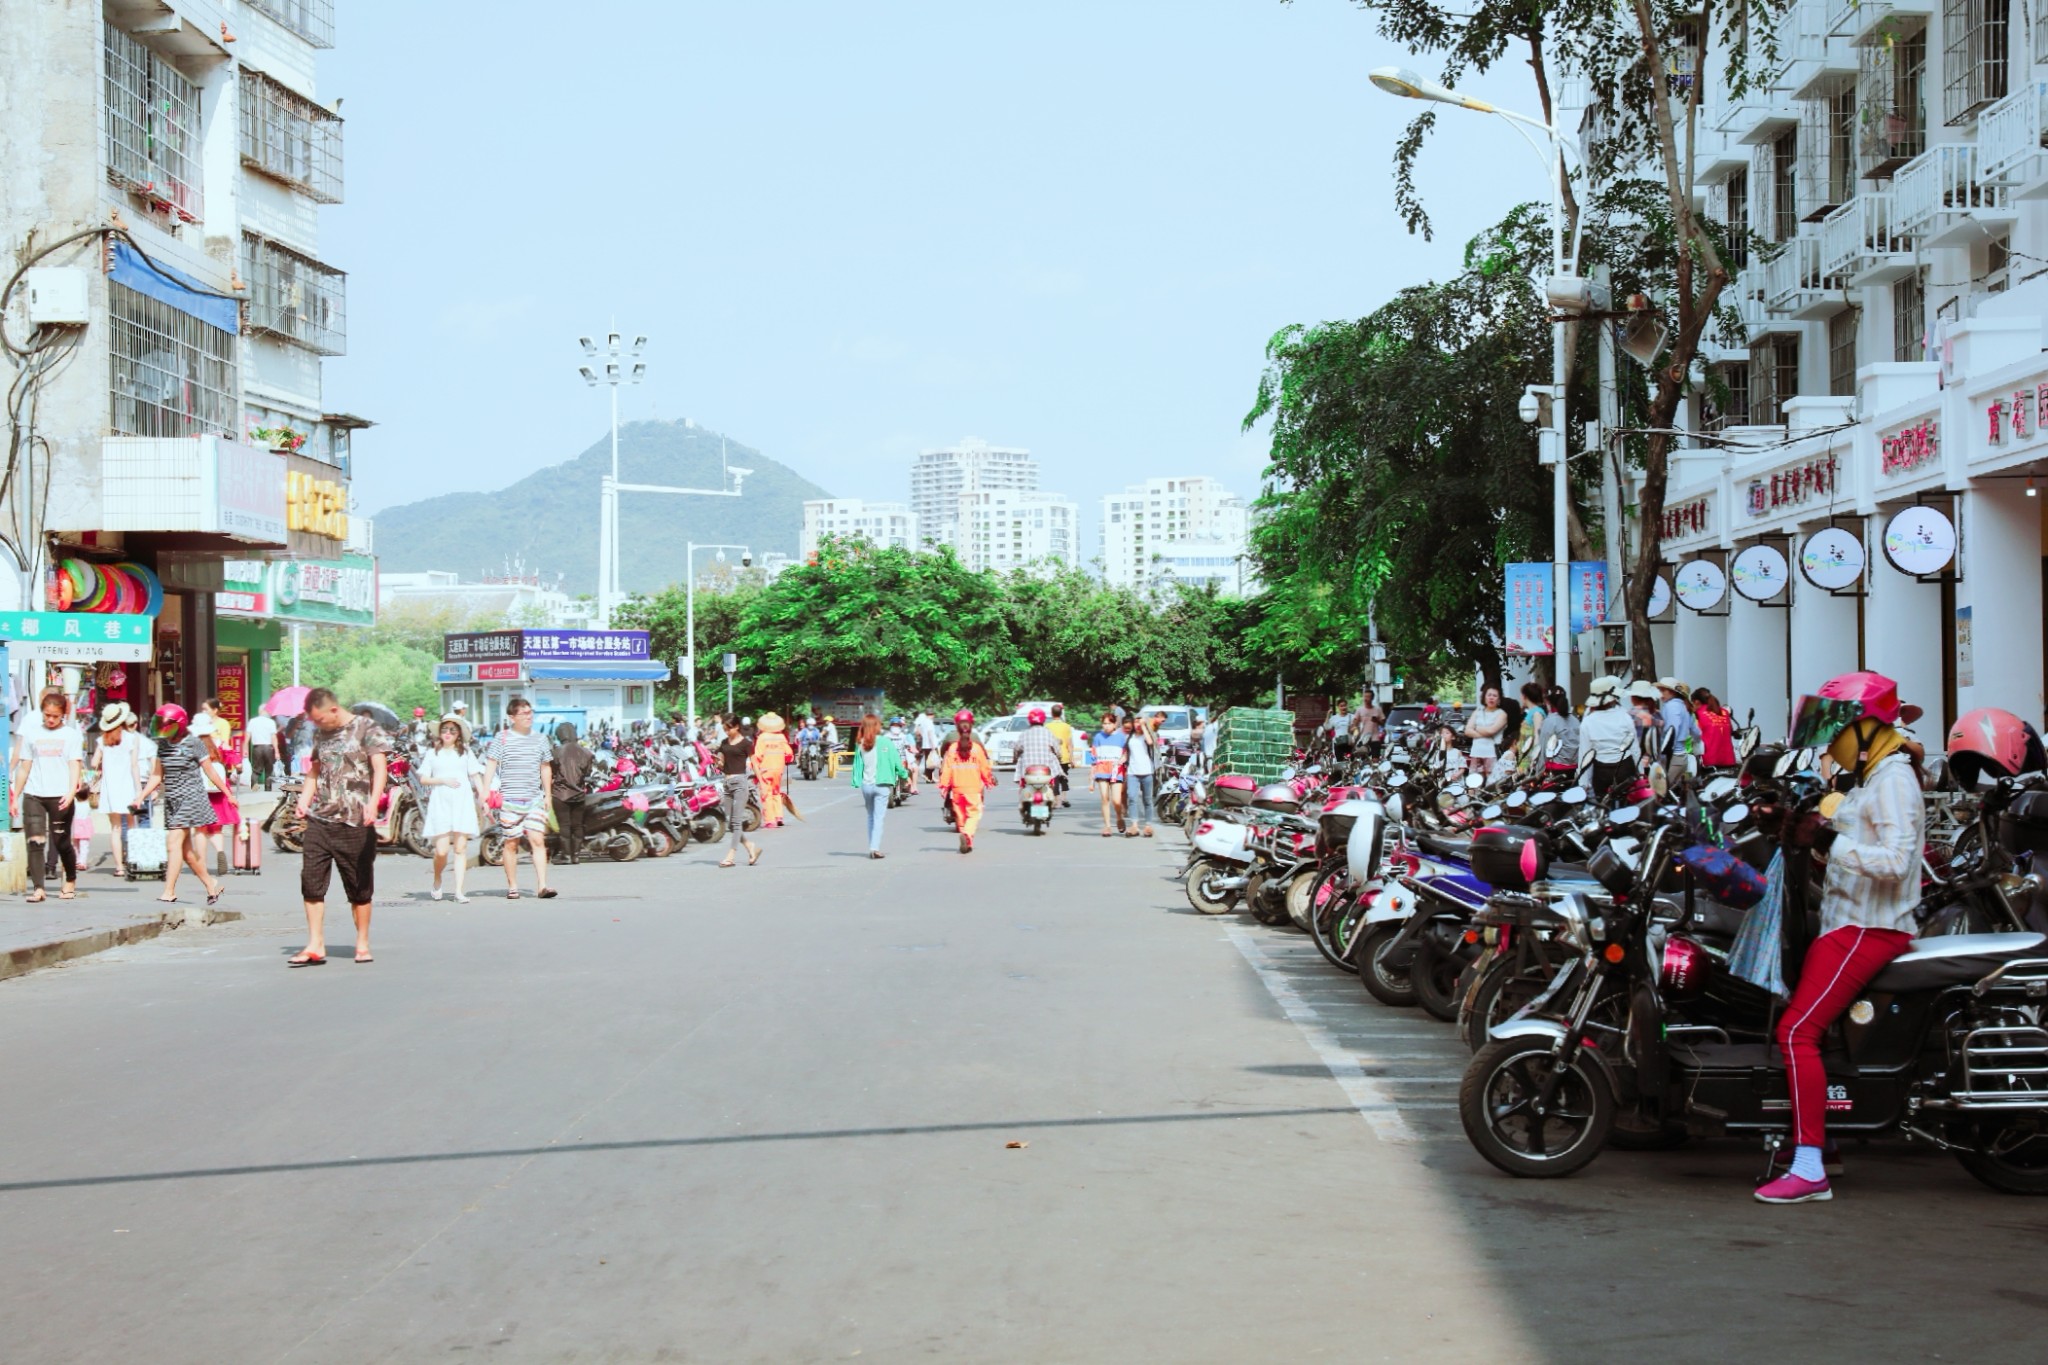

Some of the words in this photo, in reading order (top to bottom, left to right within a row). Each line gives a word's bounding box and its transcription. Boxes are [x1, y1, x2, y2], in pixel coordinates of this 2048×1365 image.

[22, 618, 121, 639] 椰风巷
[523, 636, 631, 650] 天涯区第一市场综合服务站
